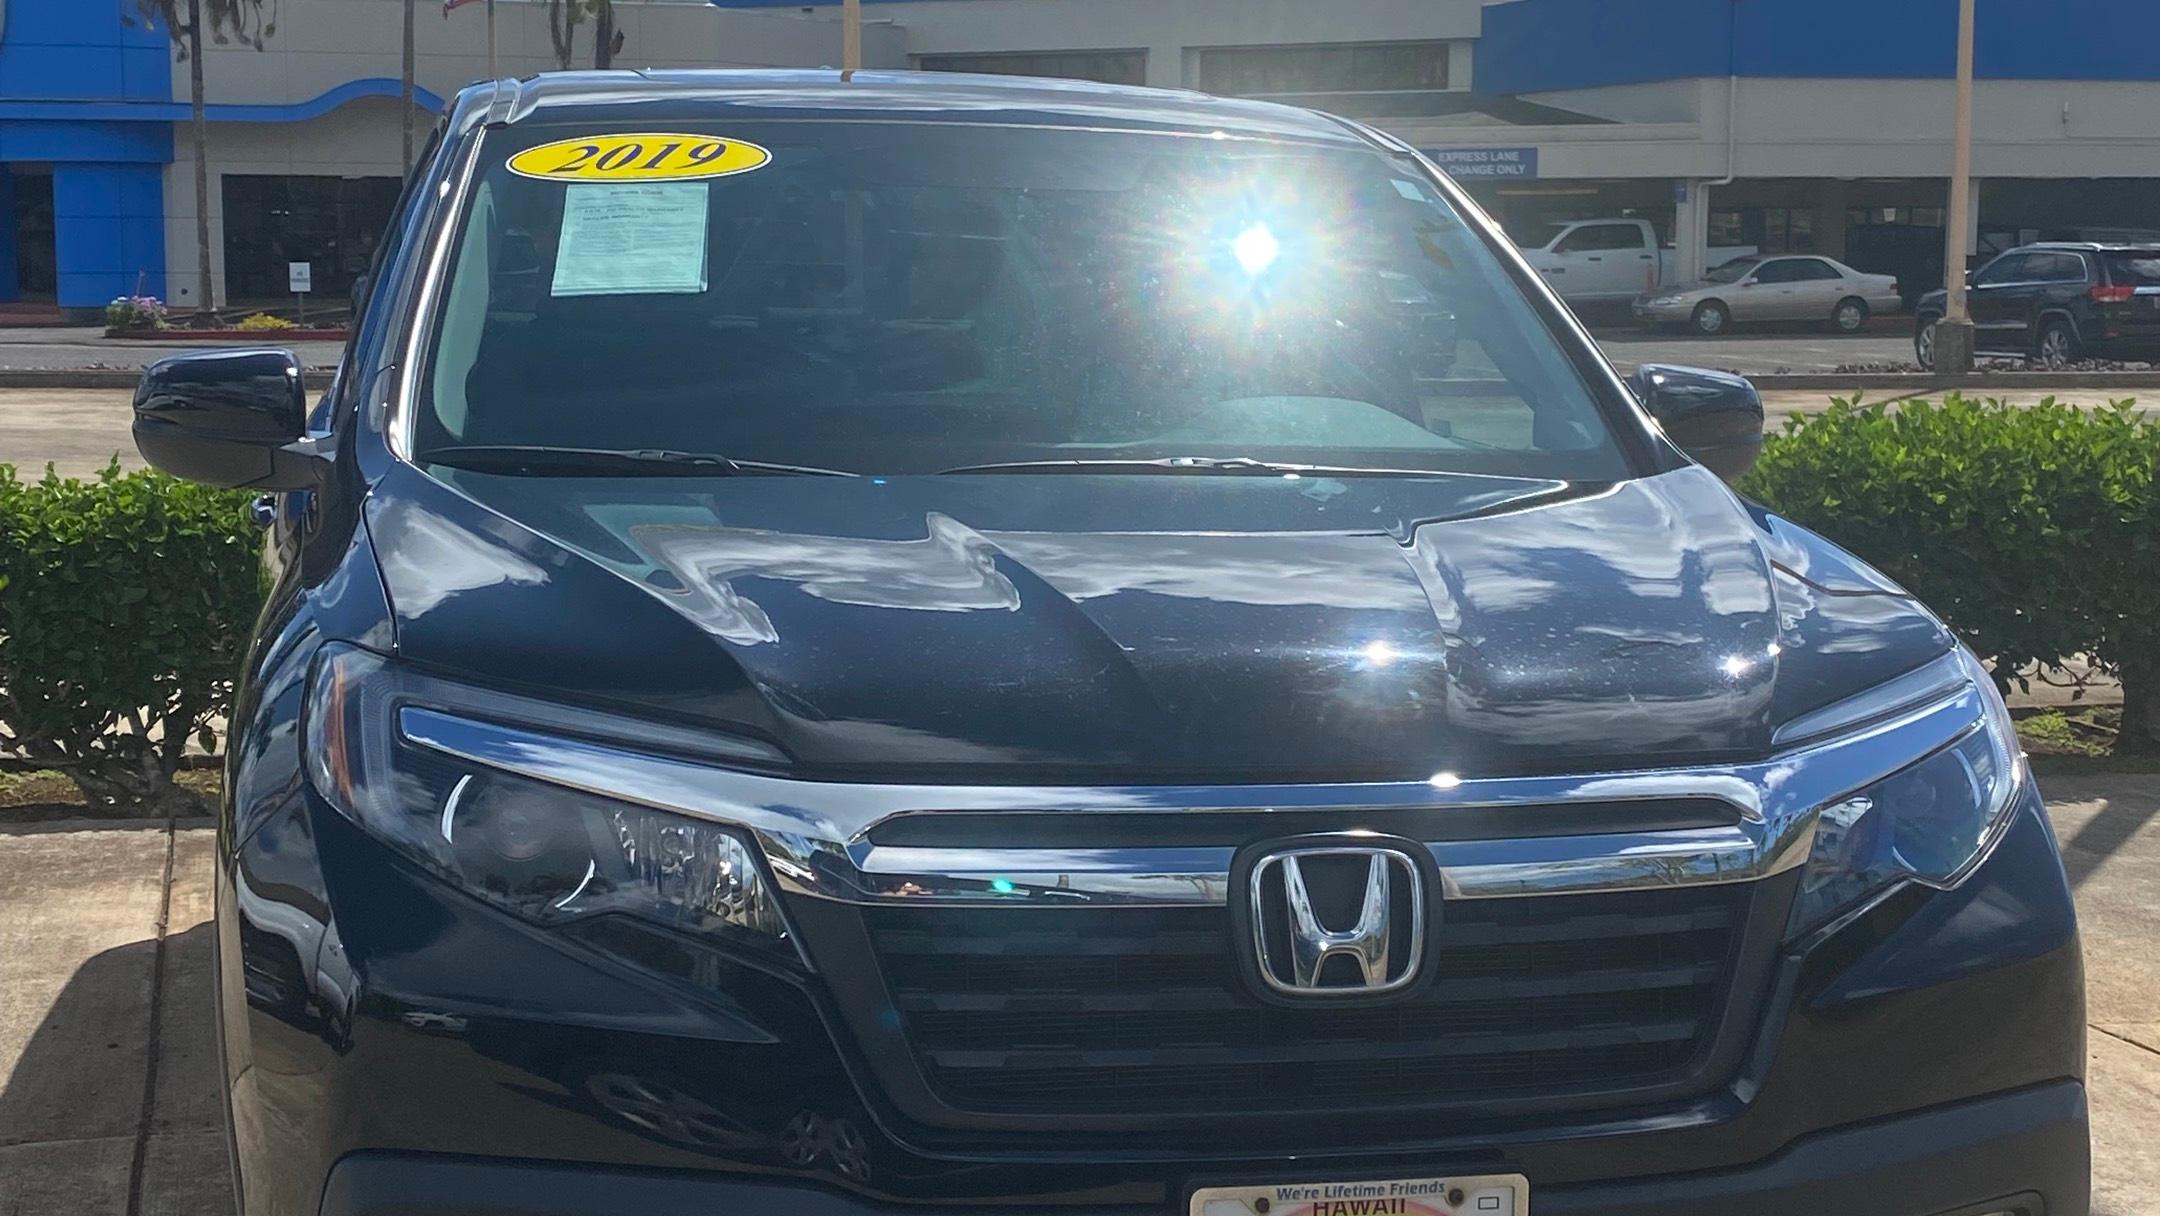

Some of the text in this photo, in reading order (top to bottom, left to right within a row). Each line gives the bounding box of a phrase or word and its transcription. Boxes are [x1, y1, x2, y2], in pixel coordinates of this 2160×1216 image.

[548, 143, 727, 173] 2019
[1438, 151, 1520, 162] EXPRESS LANE
[1448, 164, 1527, 175] CHANGE ONLY
[1276, 1181, 1446, 1201] We're Lifetime Friends
[1313, 1198, 1406, 1216] HAWAII
